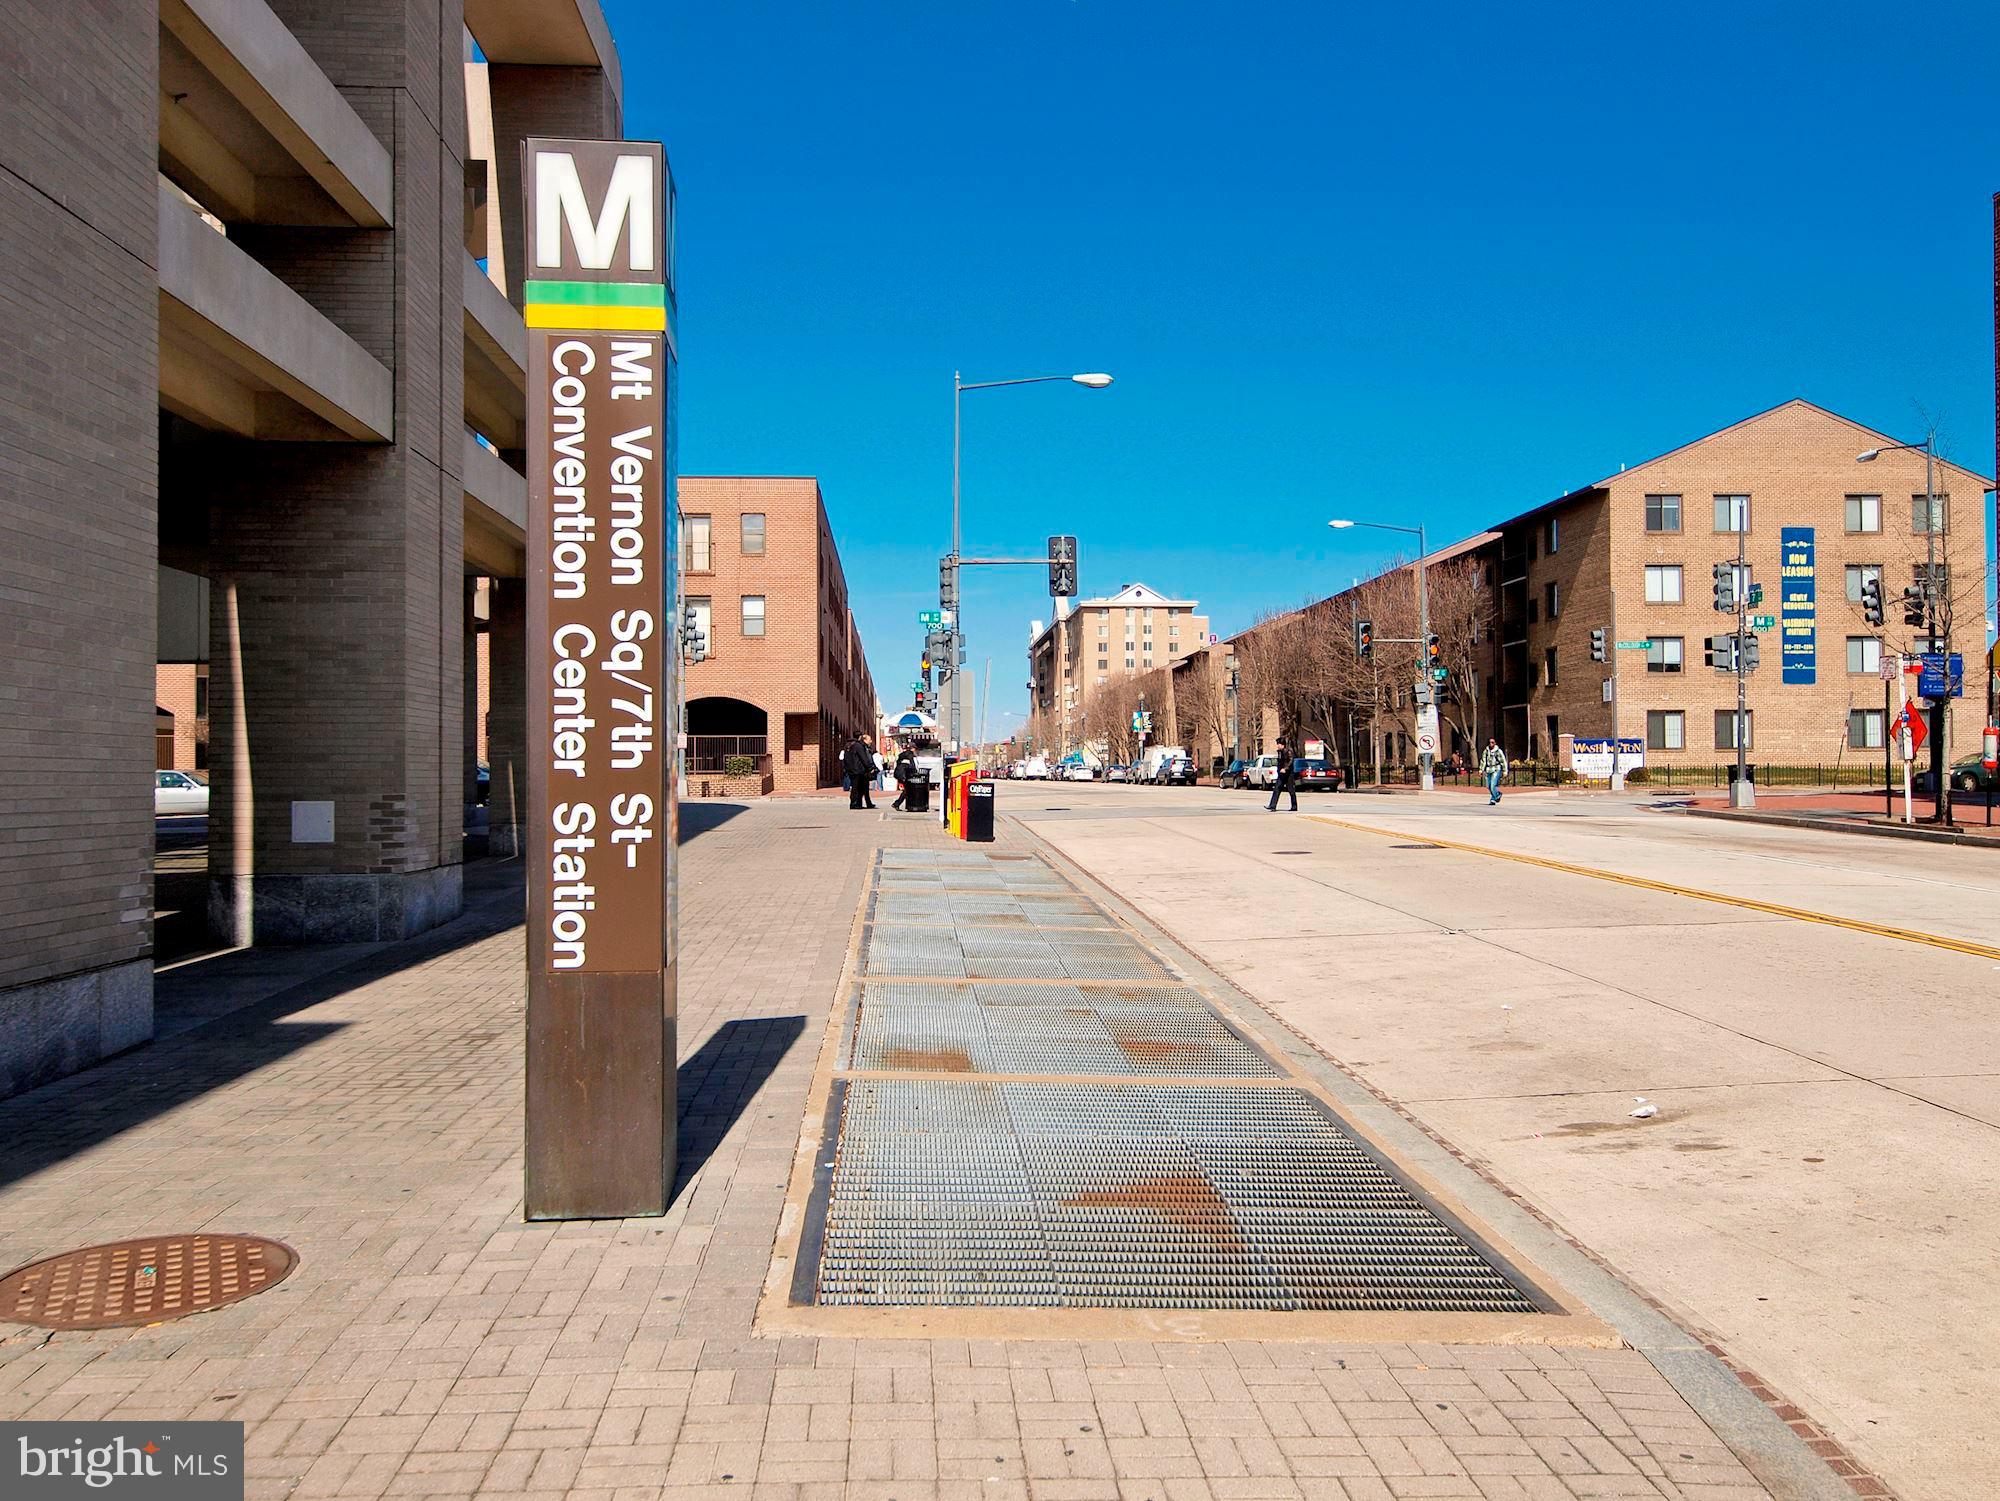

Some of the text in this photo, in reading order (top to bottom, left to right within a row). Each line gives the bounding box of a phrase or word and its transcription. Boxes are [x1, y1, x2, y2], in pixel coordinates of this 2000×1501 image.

[535, 152, 654, 270] M
[1789, 554, 1807, 565] NOW
[1782, 566, 1814, 577] LEASING
[601, 342, 654, 868] Mt Vernon Sq/7th St-
[920, 613, 930, 622] M
[1757, 617, 1765, 626] M
[552, 340, 597, 969] Convention Center Station
